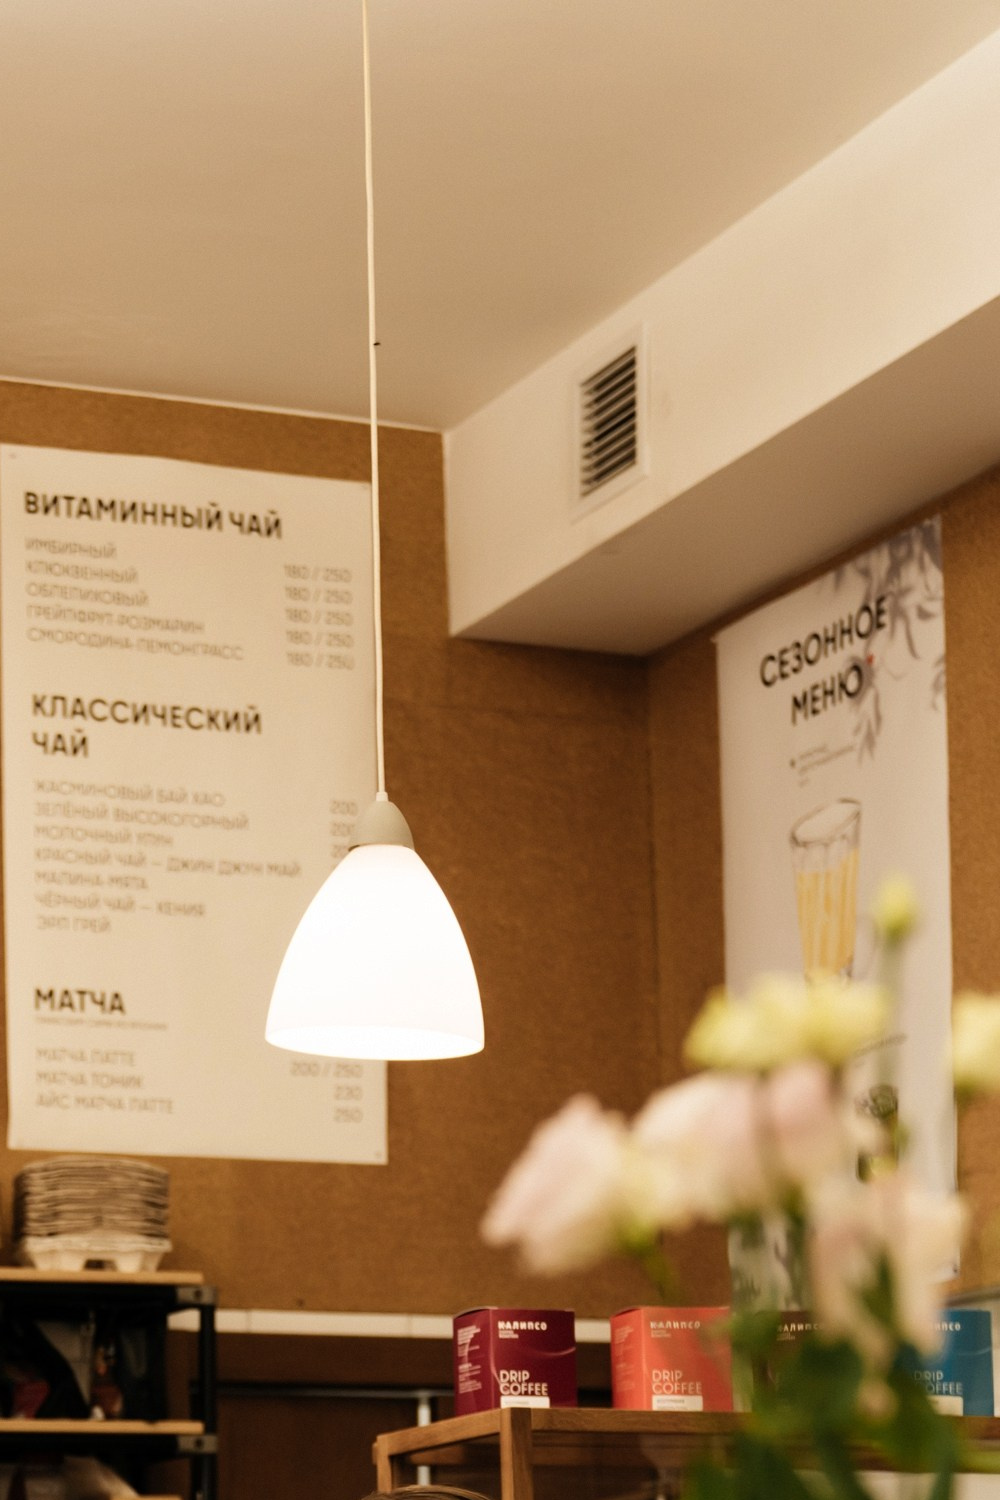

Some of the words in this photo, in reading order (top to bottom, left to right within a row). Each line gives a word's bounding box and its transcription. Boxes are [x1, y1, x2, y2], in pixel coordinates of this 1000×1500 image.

[24, 491, 223, 531] ВИТАМИННЫЙ
[229, 510, 283, 539] ЧАЙ
[759, 595, 888, 688] СЕЗОННОЕ
[790, 661, 863, 727] МЕНЮ
[32, 693, 262, 735] КЛАССИЧЕСКИЙ
[32, 728, 89, 758] ЧАЙ
[34, 988, 126, 1016] МАТЧА
[500, 1369, 530, 1383] DRIP
[500, 1382, 548, 1396] COFFEE
[652, 1369, 683, 1382] DRIP
[652, 1382, 703, 1395] COFFEE
[925, 1381, 963, 1395] OFFEE
